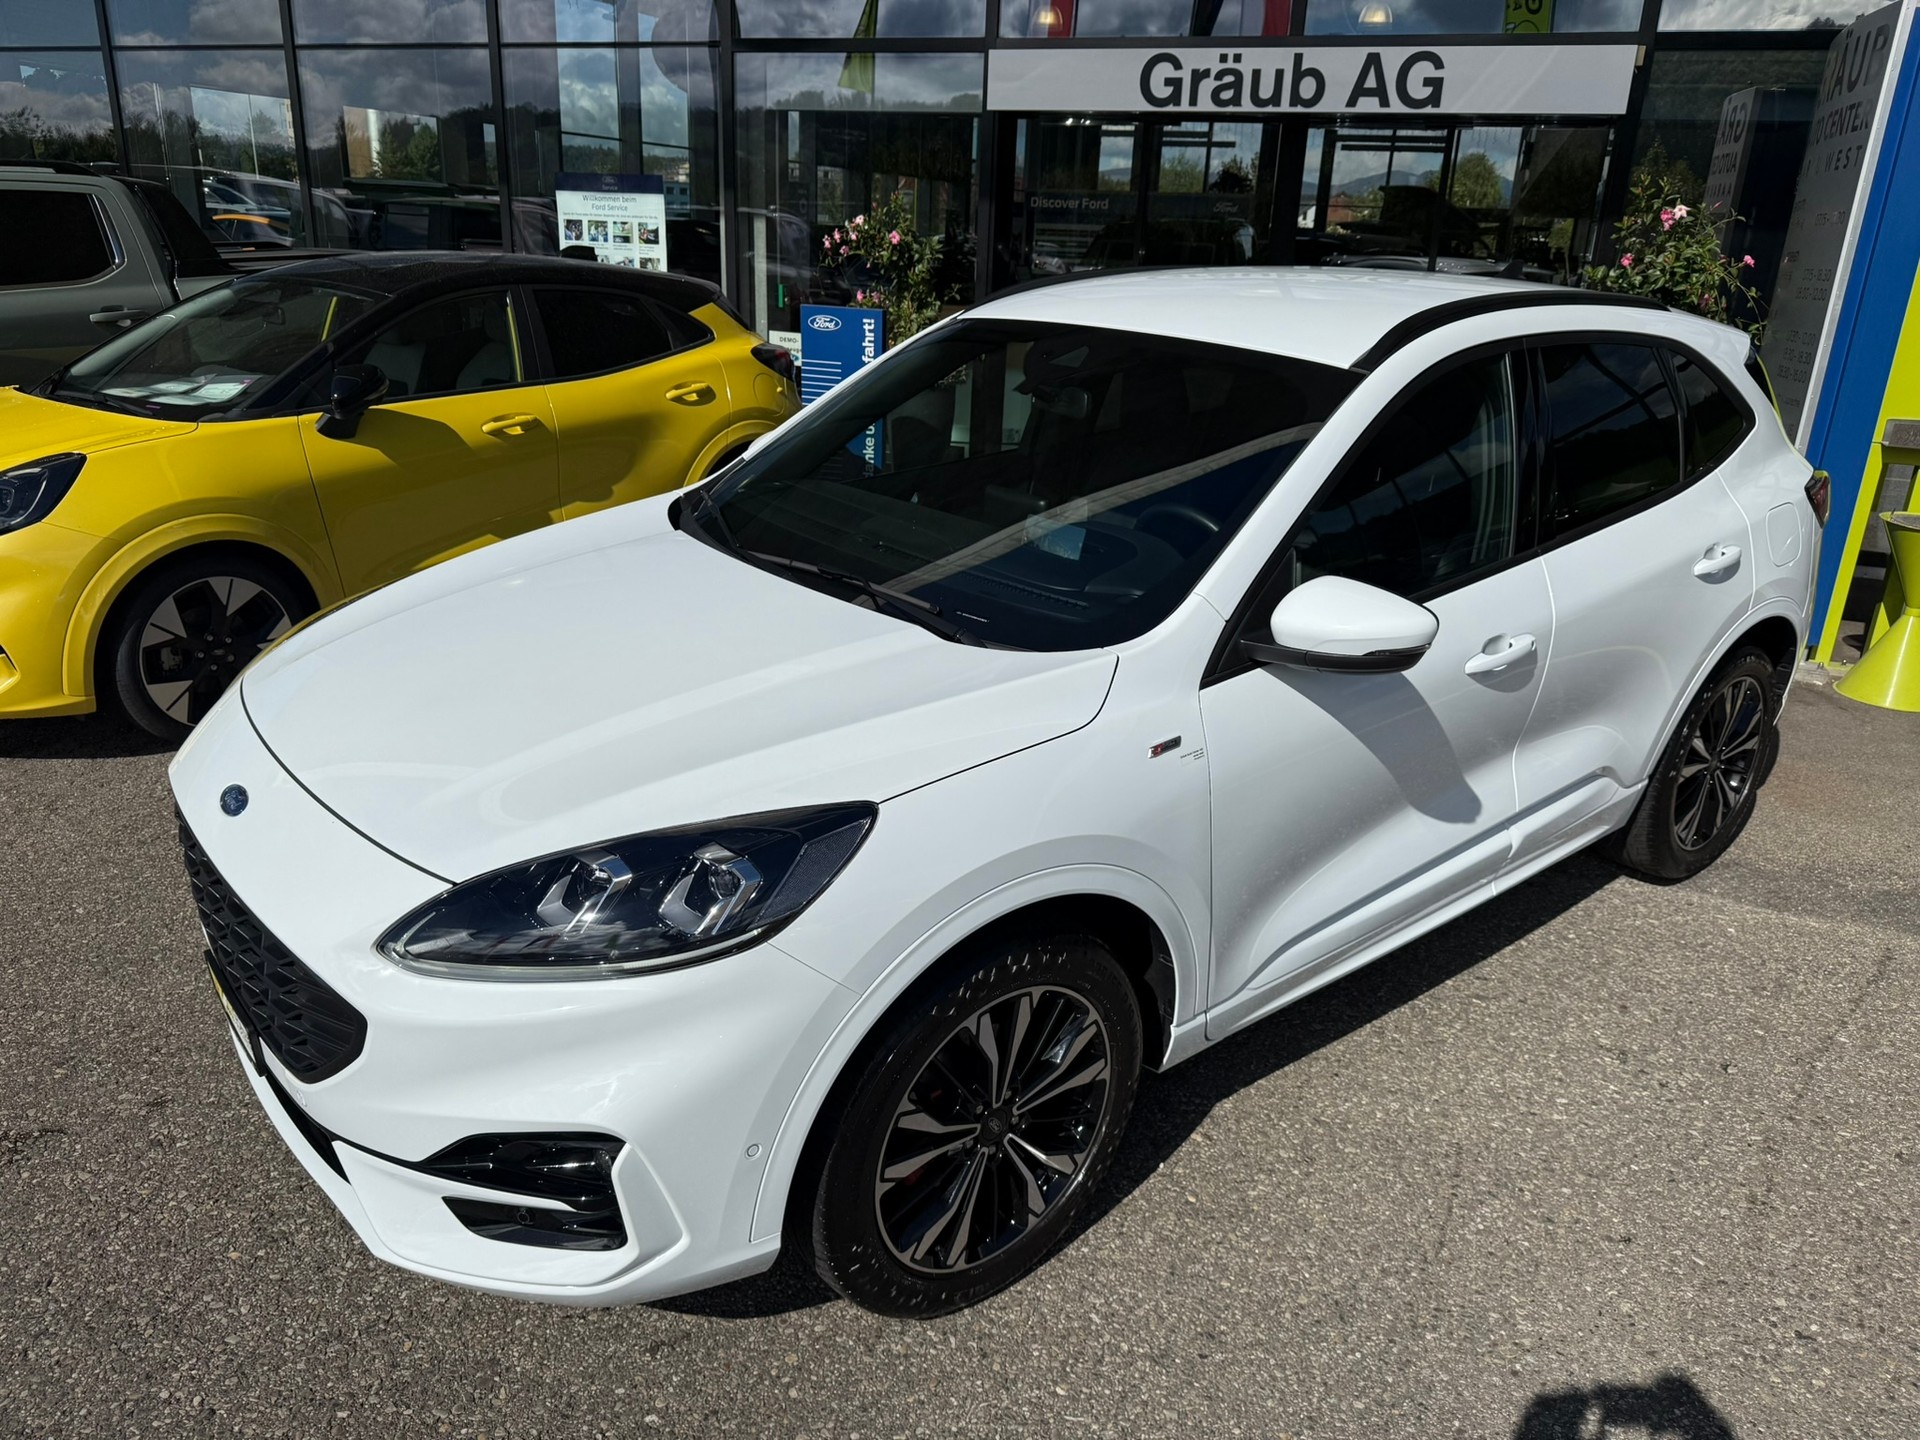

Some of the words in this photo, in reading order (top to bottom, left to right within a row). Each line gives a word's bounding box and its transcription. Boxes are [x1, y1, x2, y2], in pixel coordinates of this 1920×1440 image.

[1140, 52, 1326, 109] Gräub
[1344, 50, 1446, 110] AG
[1825, 145, 1863, 173] WEST
[582, 194, 621, 203] Willkommen
[1030, 196, 1080, 209] Discover
[1082, 197, 1109, 210] Ford
[591, 203, 606, 211] Ford
[607, 204, 628, 212] Service
[811, 316, 838, 329] Ford
[779, 336, 800, 344] DEMO-
